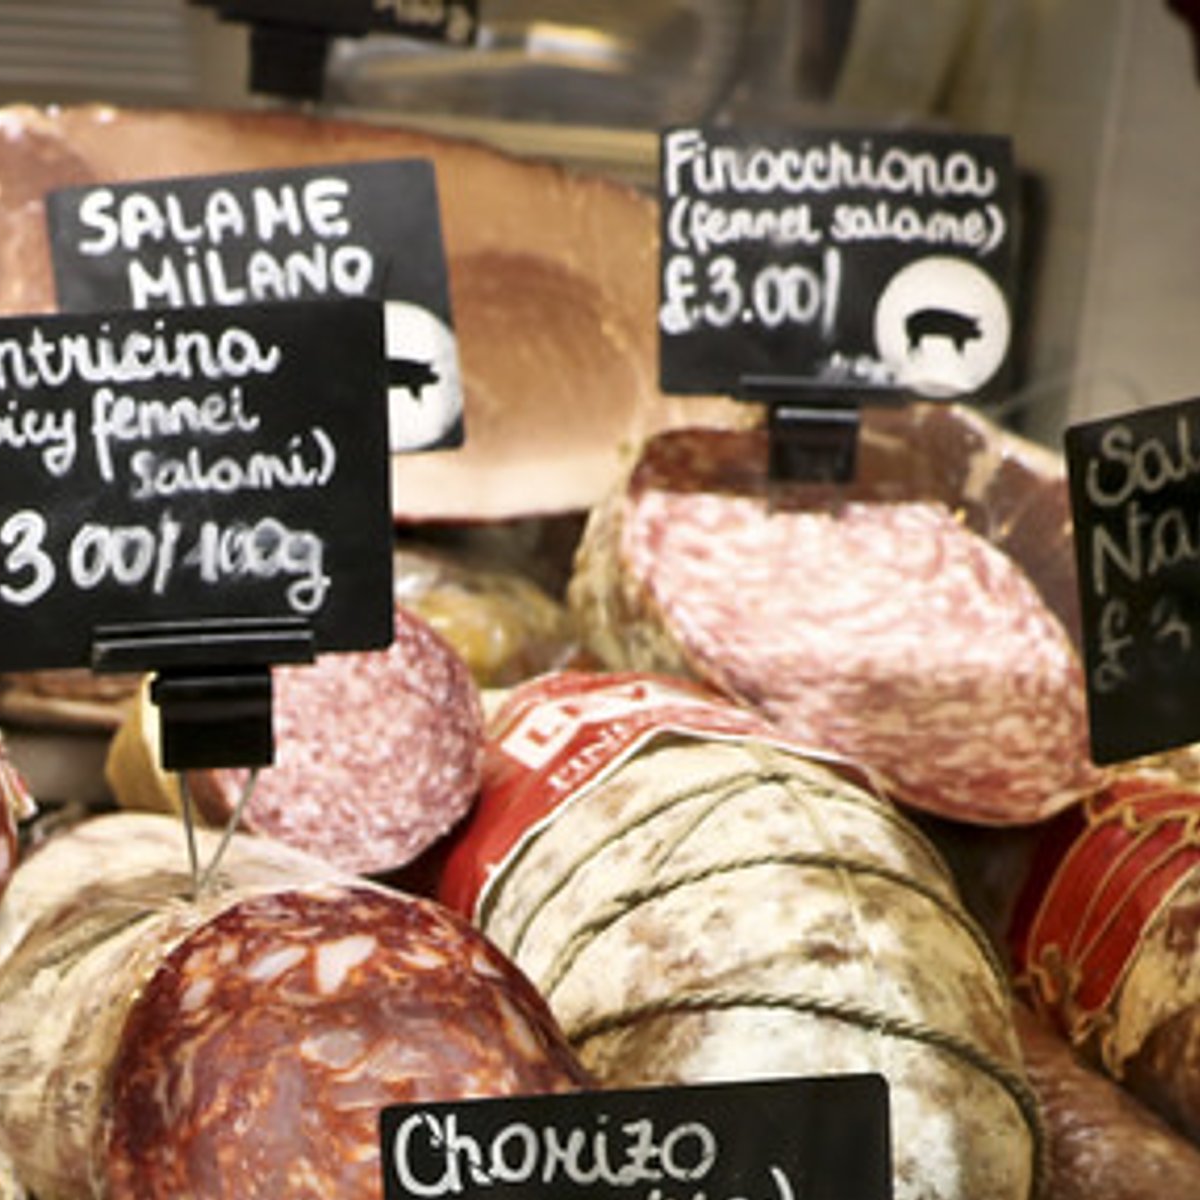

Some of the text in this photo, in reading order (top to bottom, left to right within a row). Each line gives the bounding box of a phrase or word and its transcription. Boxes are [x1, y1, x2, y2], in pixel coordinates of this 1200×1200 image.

[664, 129, 996, 197] Finocchiona
[79, 178, 350, 254] SALAME
[1086, 414, 1200, 507] Sal
